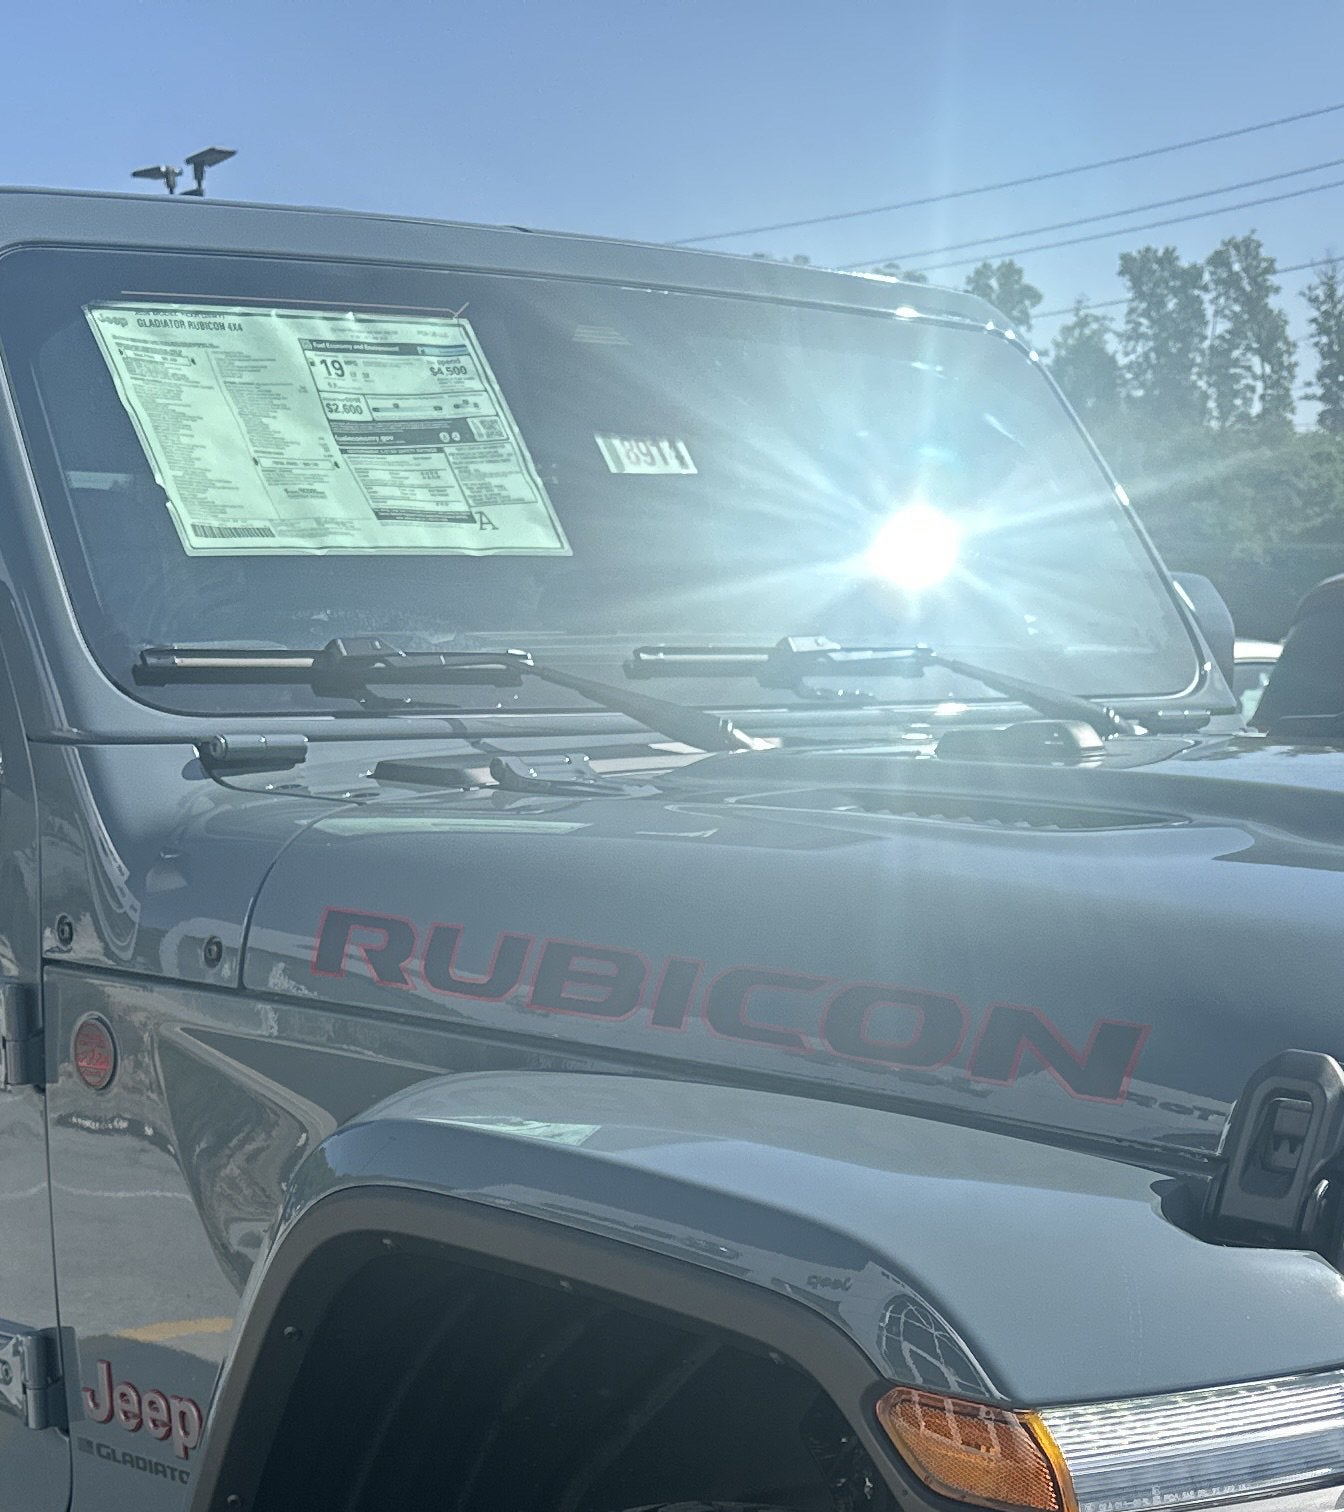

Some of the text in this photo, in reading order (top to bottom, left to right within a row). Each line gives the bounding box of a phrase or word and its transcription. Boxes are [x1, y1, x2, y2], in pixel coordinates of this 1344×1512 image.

[136, 317, 244, 333] GLADIATOR RUBICON 4X4
[320, 358, 346, 379] 19
[325, 403, 363, 416] $2,600
[474, 510, 500, 531] A
[309, 905, 1152, 1106] RUBICON
[80, 1358, 205, 1461] Jeep
